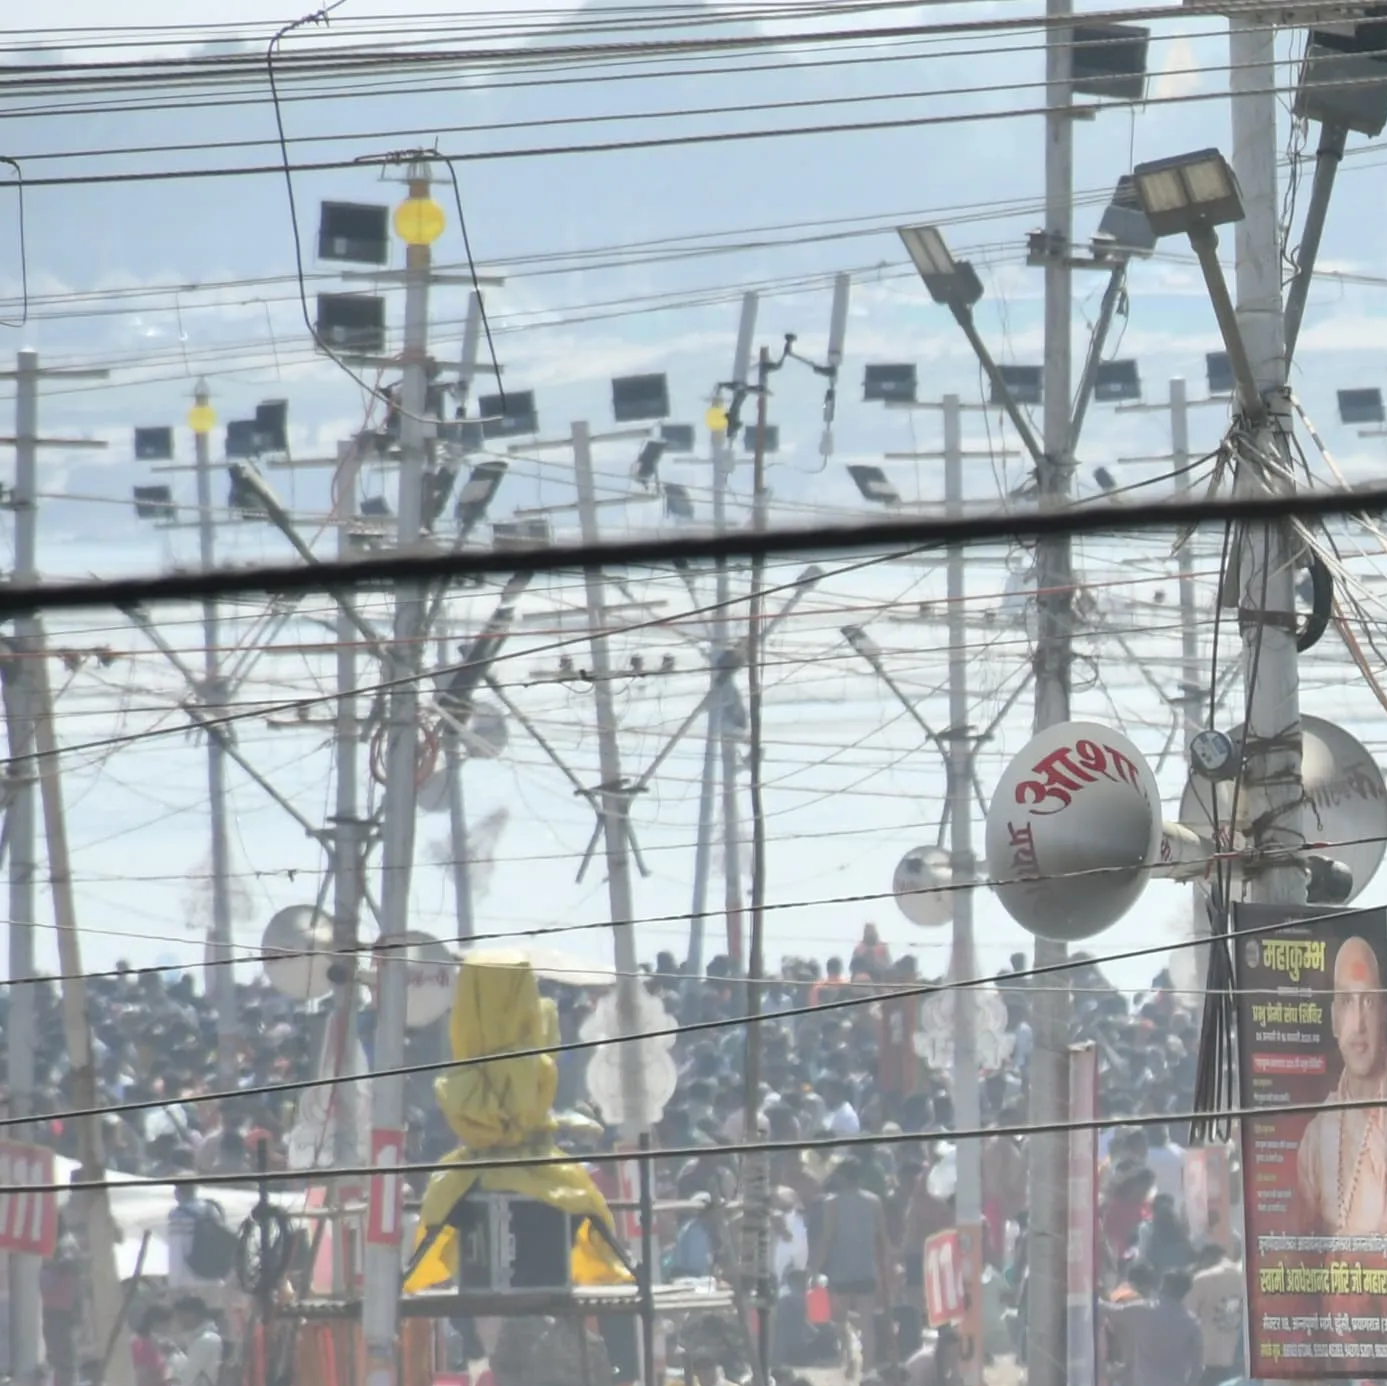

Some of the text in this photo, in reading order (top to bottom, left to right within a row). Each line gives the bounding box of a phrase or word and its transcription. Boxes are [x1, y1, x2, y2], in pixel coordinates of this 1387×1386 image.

[1015, 739, 1140, 816] आशा
[1262, 939, 1326, 981] महाकुम्भ
[1260, 1262, 1284, 1294] स्वामी
[1349, 1262, 1362, 1294] जी
